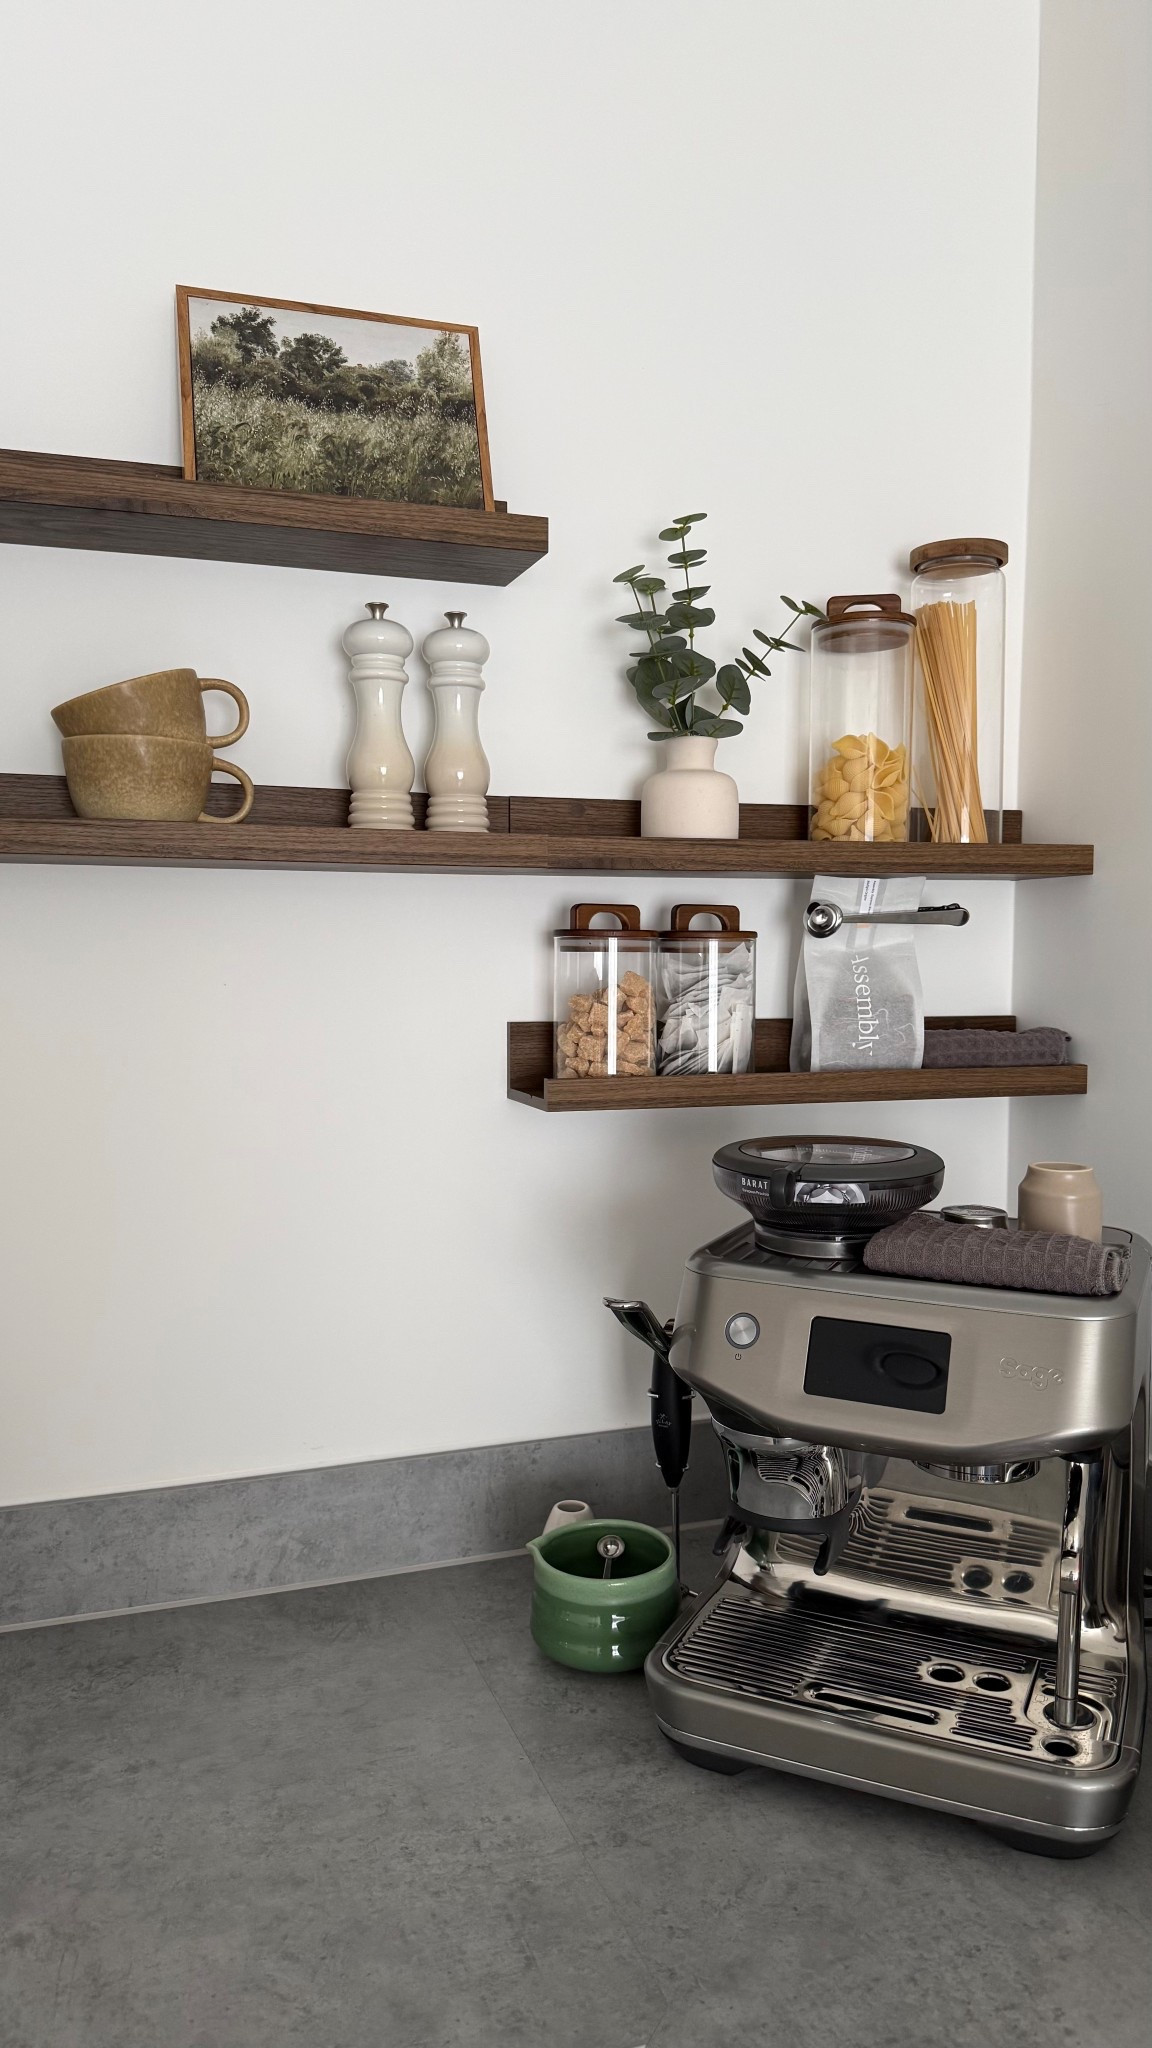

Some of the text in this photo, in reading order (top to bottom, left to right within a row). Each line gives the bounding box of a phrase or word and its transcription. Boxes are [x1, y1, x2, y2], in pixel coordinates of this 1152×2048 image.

[851, 954, 879, 1057] Assembly
[741, 1177, 768, 1190] BARAT
[999, 1357, 1064, 1391] Sage
